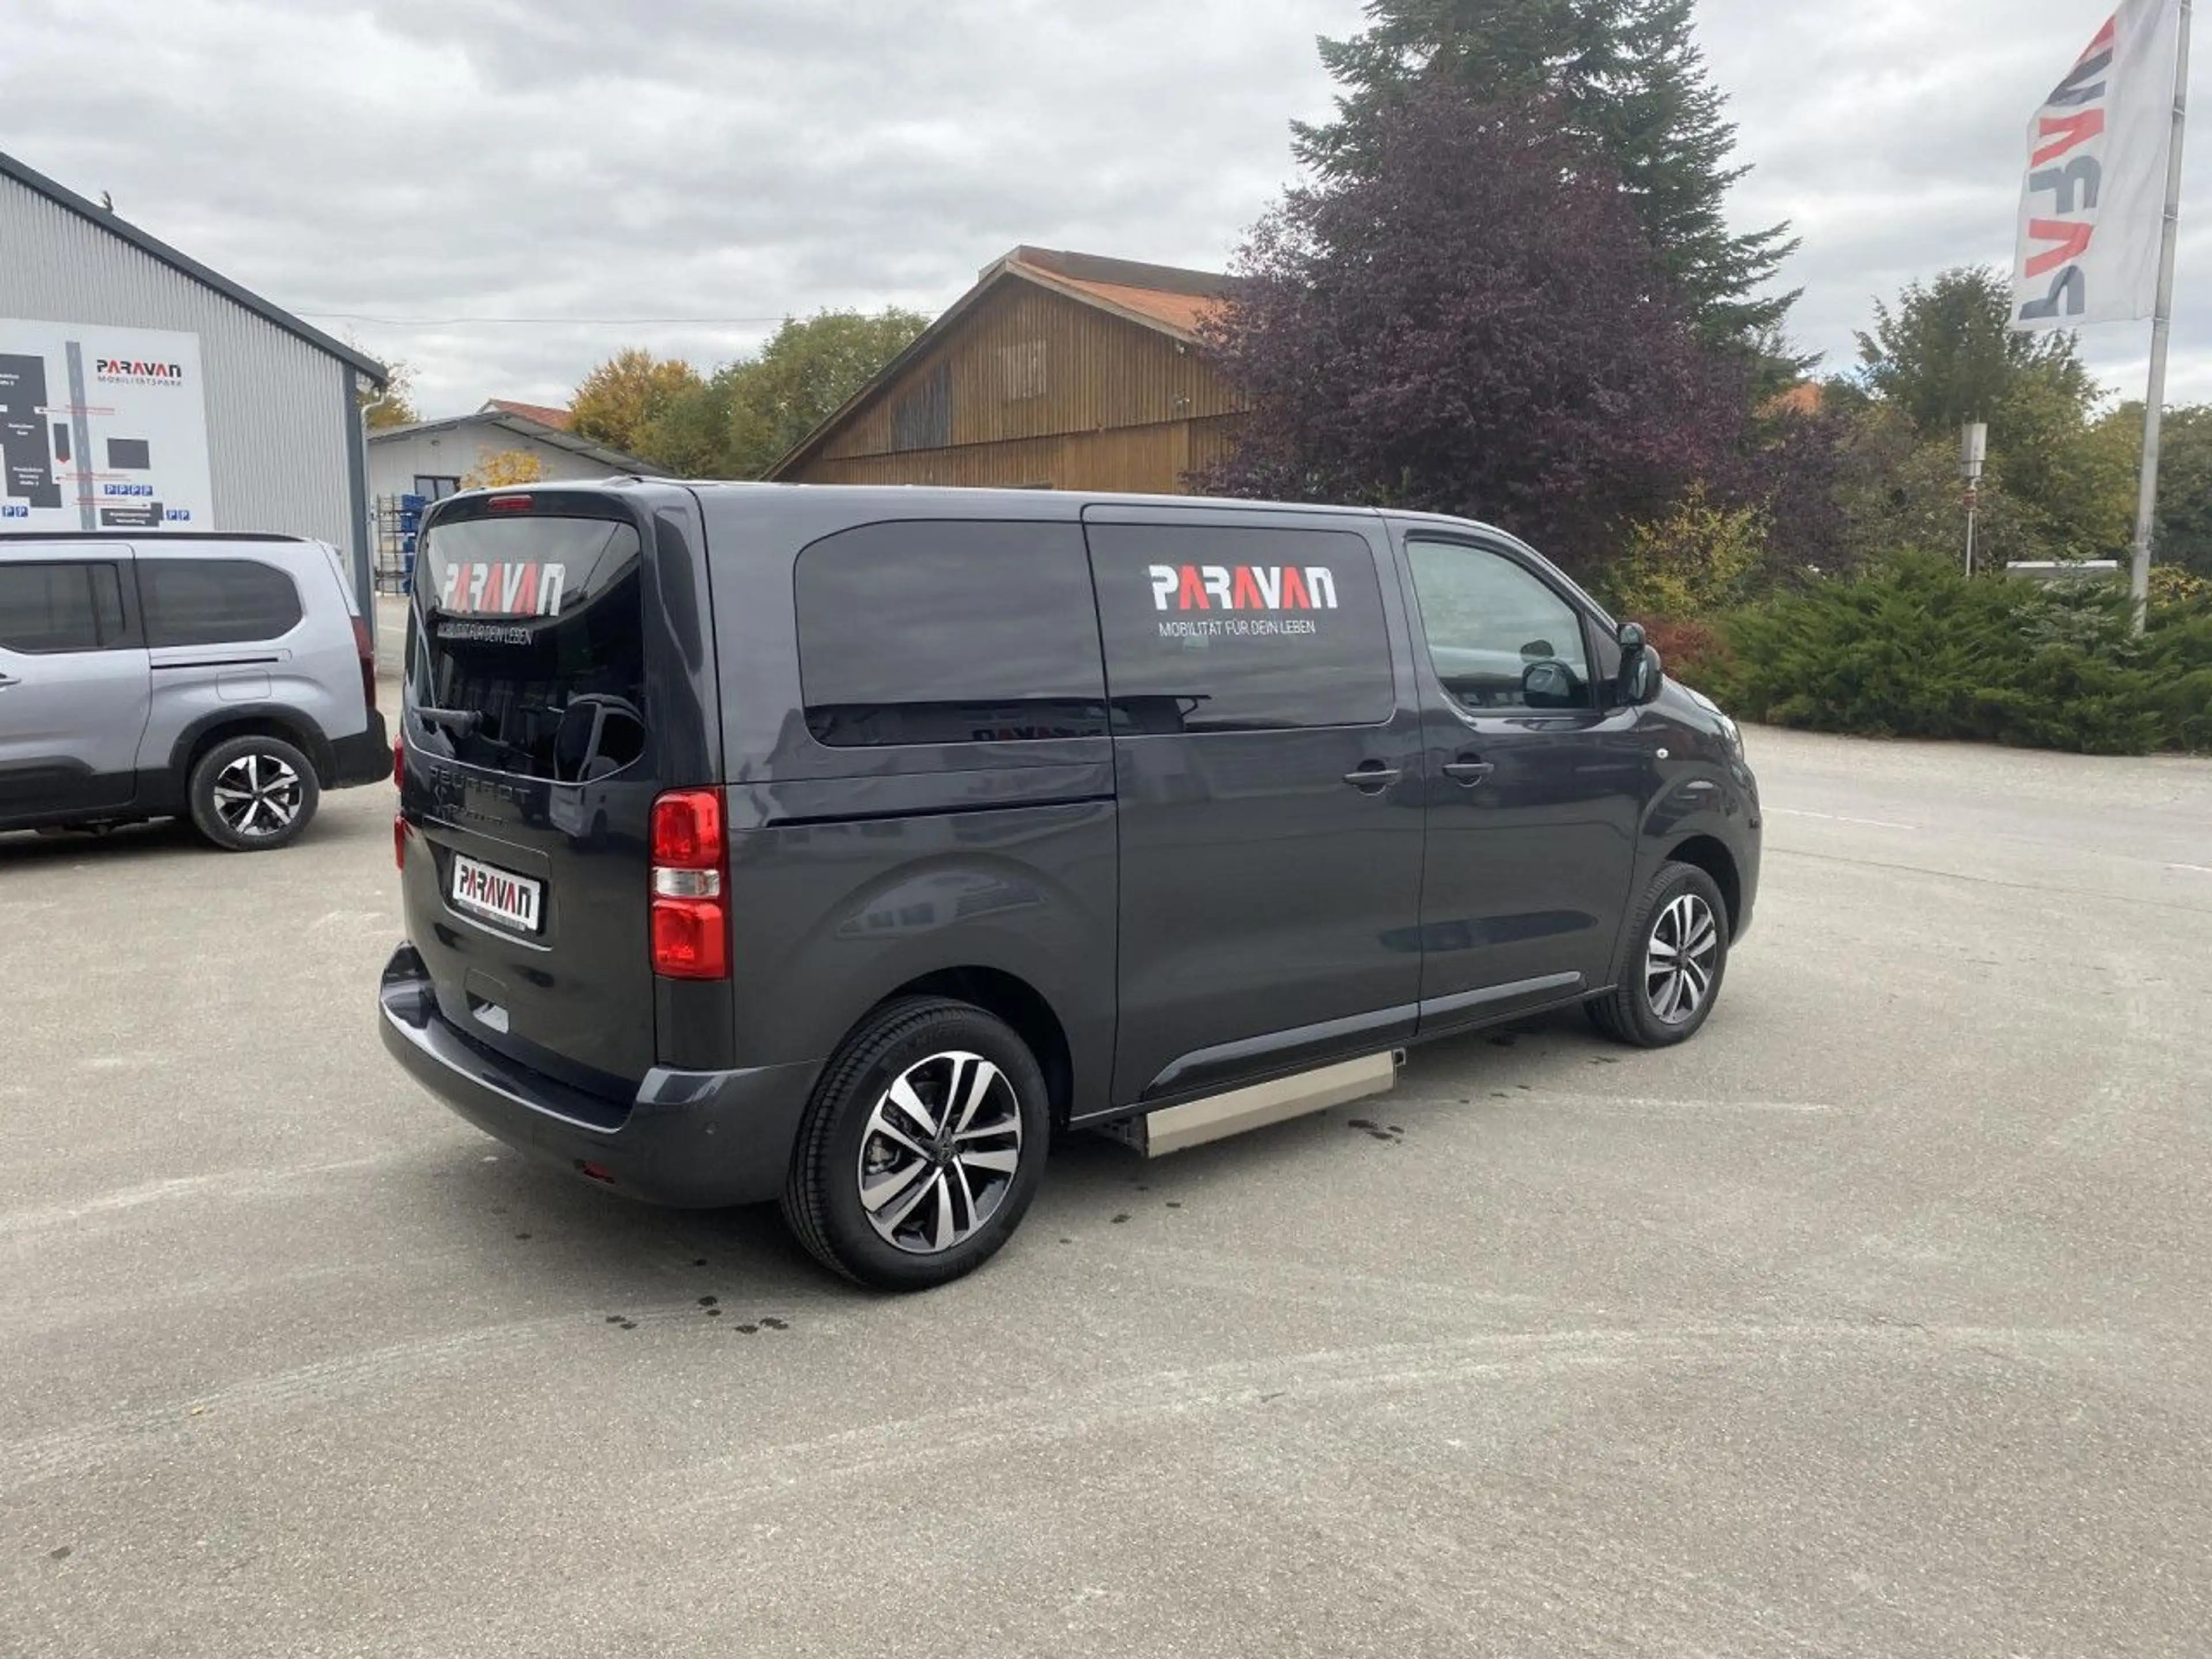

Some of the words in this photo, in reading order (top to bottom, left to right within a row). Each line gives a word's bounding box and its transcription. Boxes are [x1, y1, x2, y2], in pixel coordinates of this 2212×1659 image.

[96, 359, 182, 377] PARAVAN
[441, 560, 566, 617] PARAVAN
[1149, 564, 1338, 610] PARAVAN
[1158, 618, 1222, 637] MOBILITÄT
[1225, 617, 1250, 635] FÜR
[1251, 619, 1279, 635] DEIN
[1280, 619, 1316, 634] LEBEN
[459, 863, 532, 919] PARAVAN
